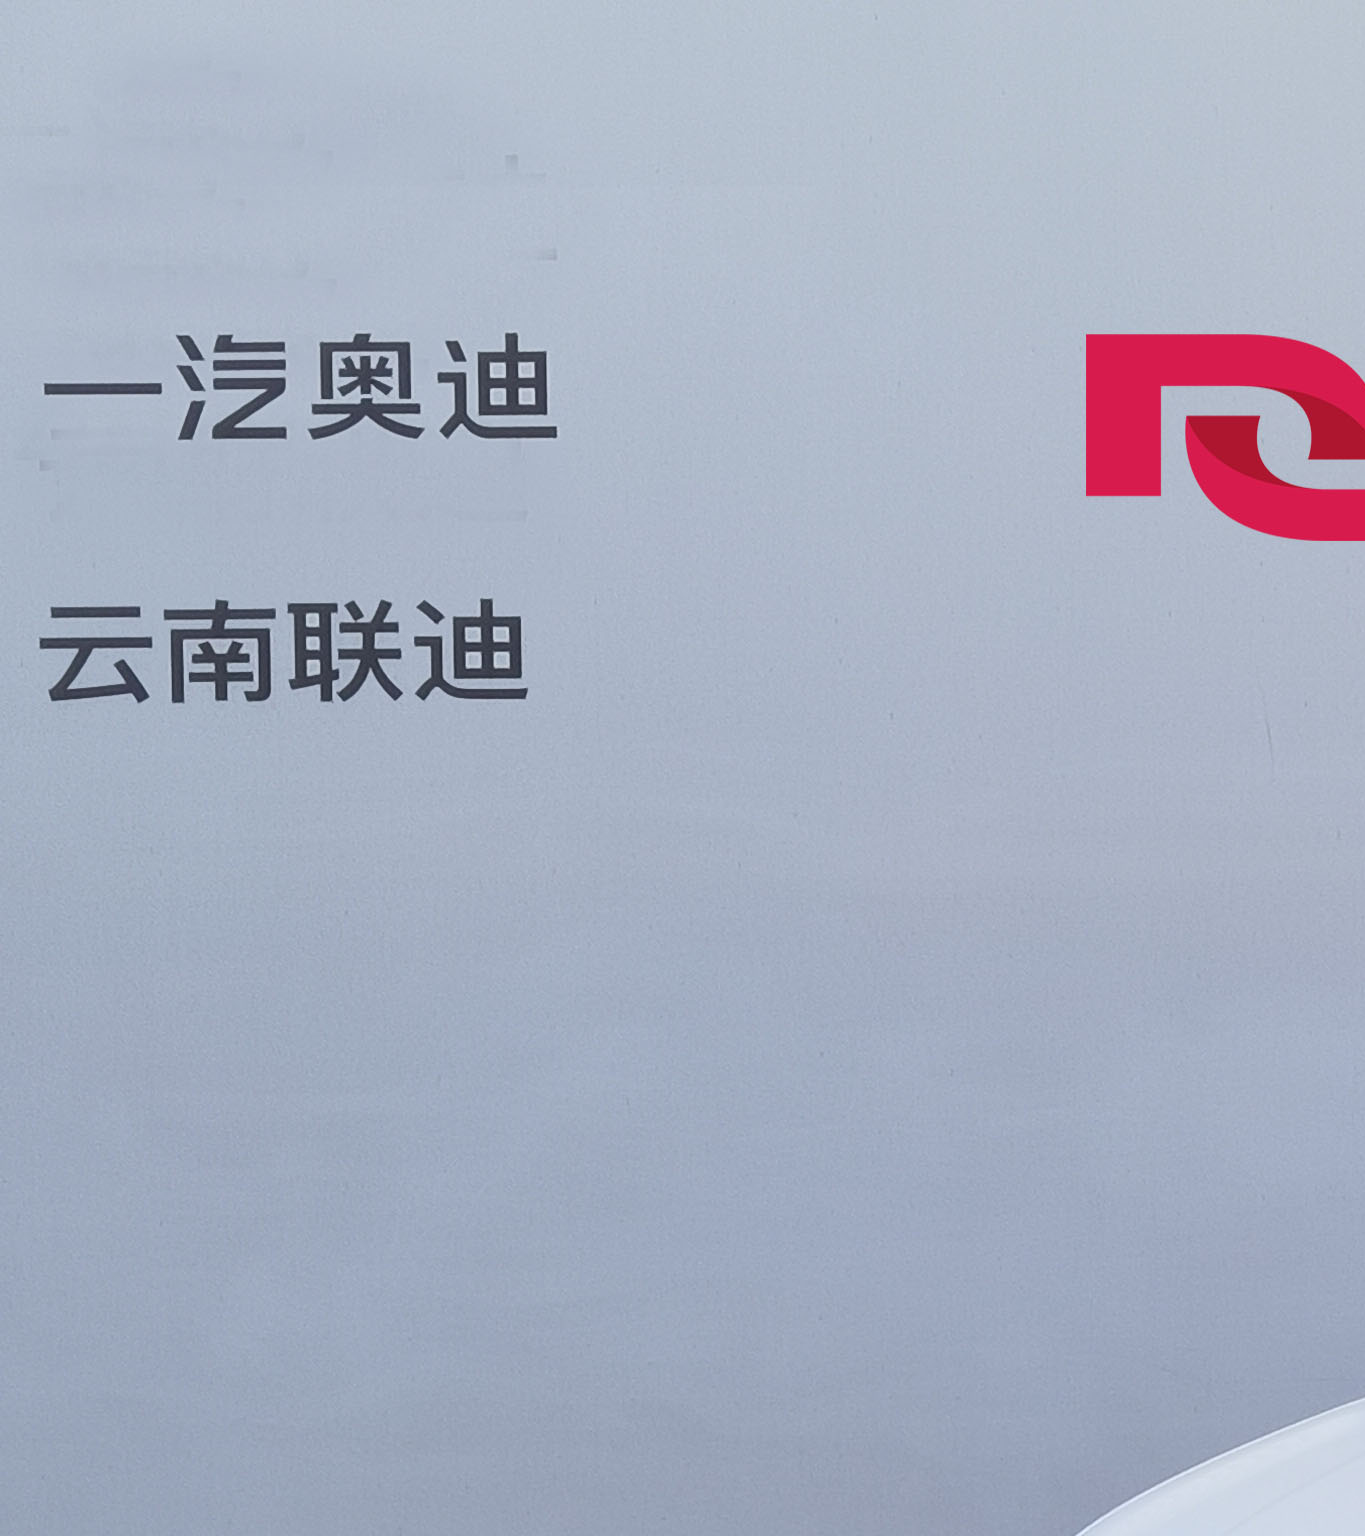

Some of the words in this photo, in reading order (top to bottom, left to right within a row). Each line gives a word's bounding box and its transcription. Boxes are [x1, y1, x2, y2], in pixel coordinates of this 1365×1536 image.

[44, 333, 557, 440] 一汽奥迪
[40, 599, 528, 703] 云南联迪
